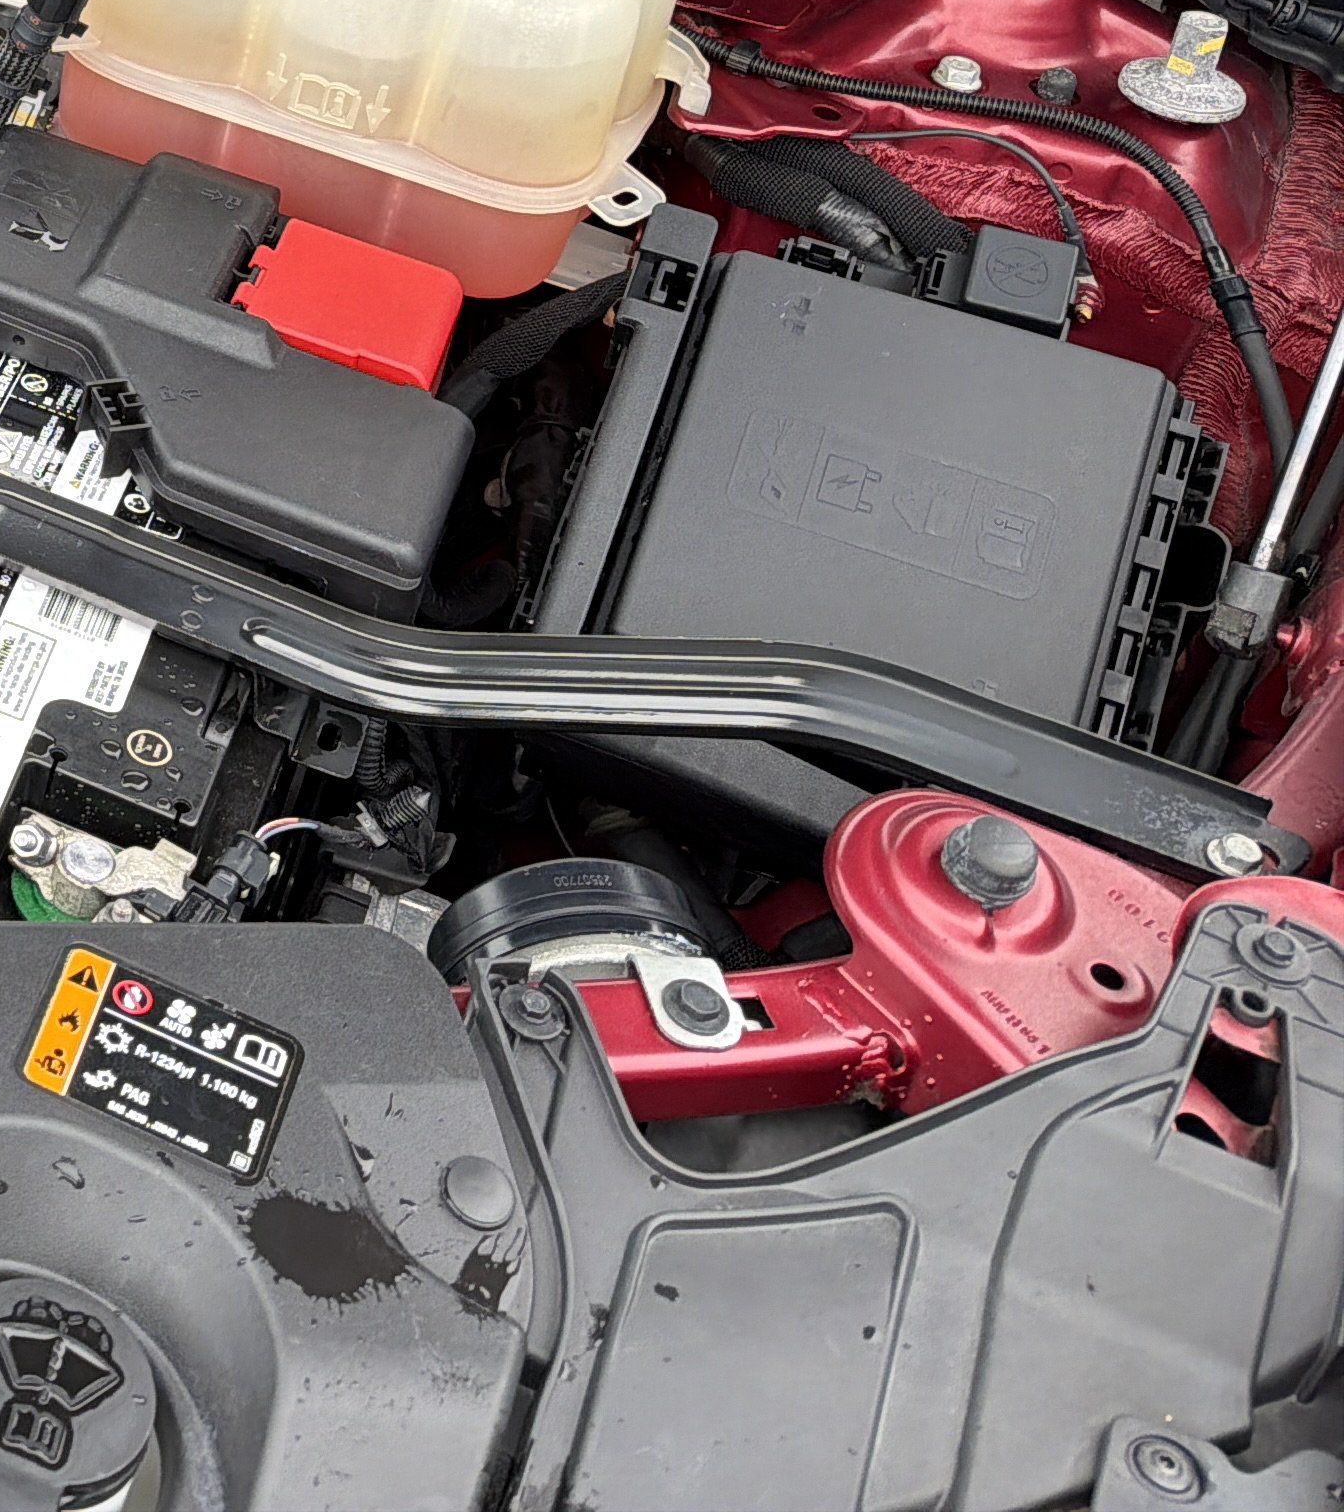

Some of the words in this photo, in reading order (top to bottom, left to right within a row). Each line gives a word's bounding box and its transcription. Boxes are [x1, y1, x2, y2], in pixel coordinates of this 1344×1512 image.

[159, 1016, 192, 1038] AUTO
[119, 1083, 151, 1107] PAG
[199, 1073, 238, 1101] 1.100
[238, 1086, 258, 1110] kg
